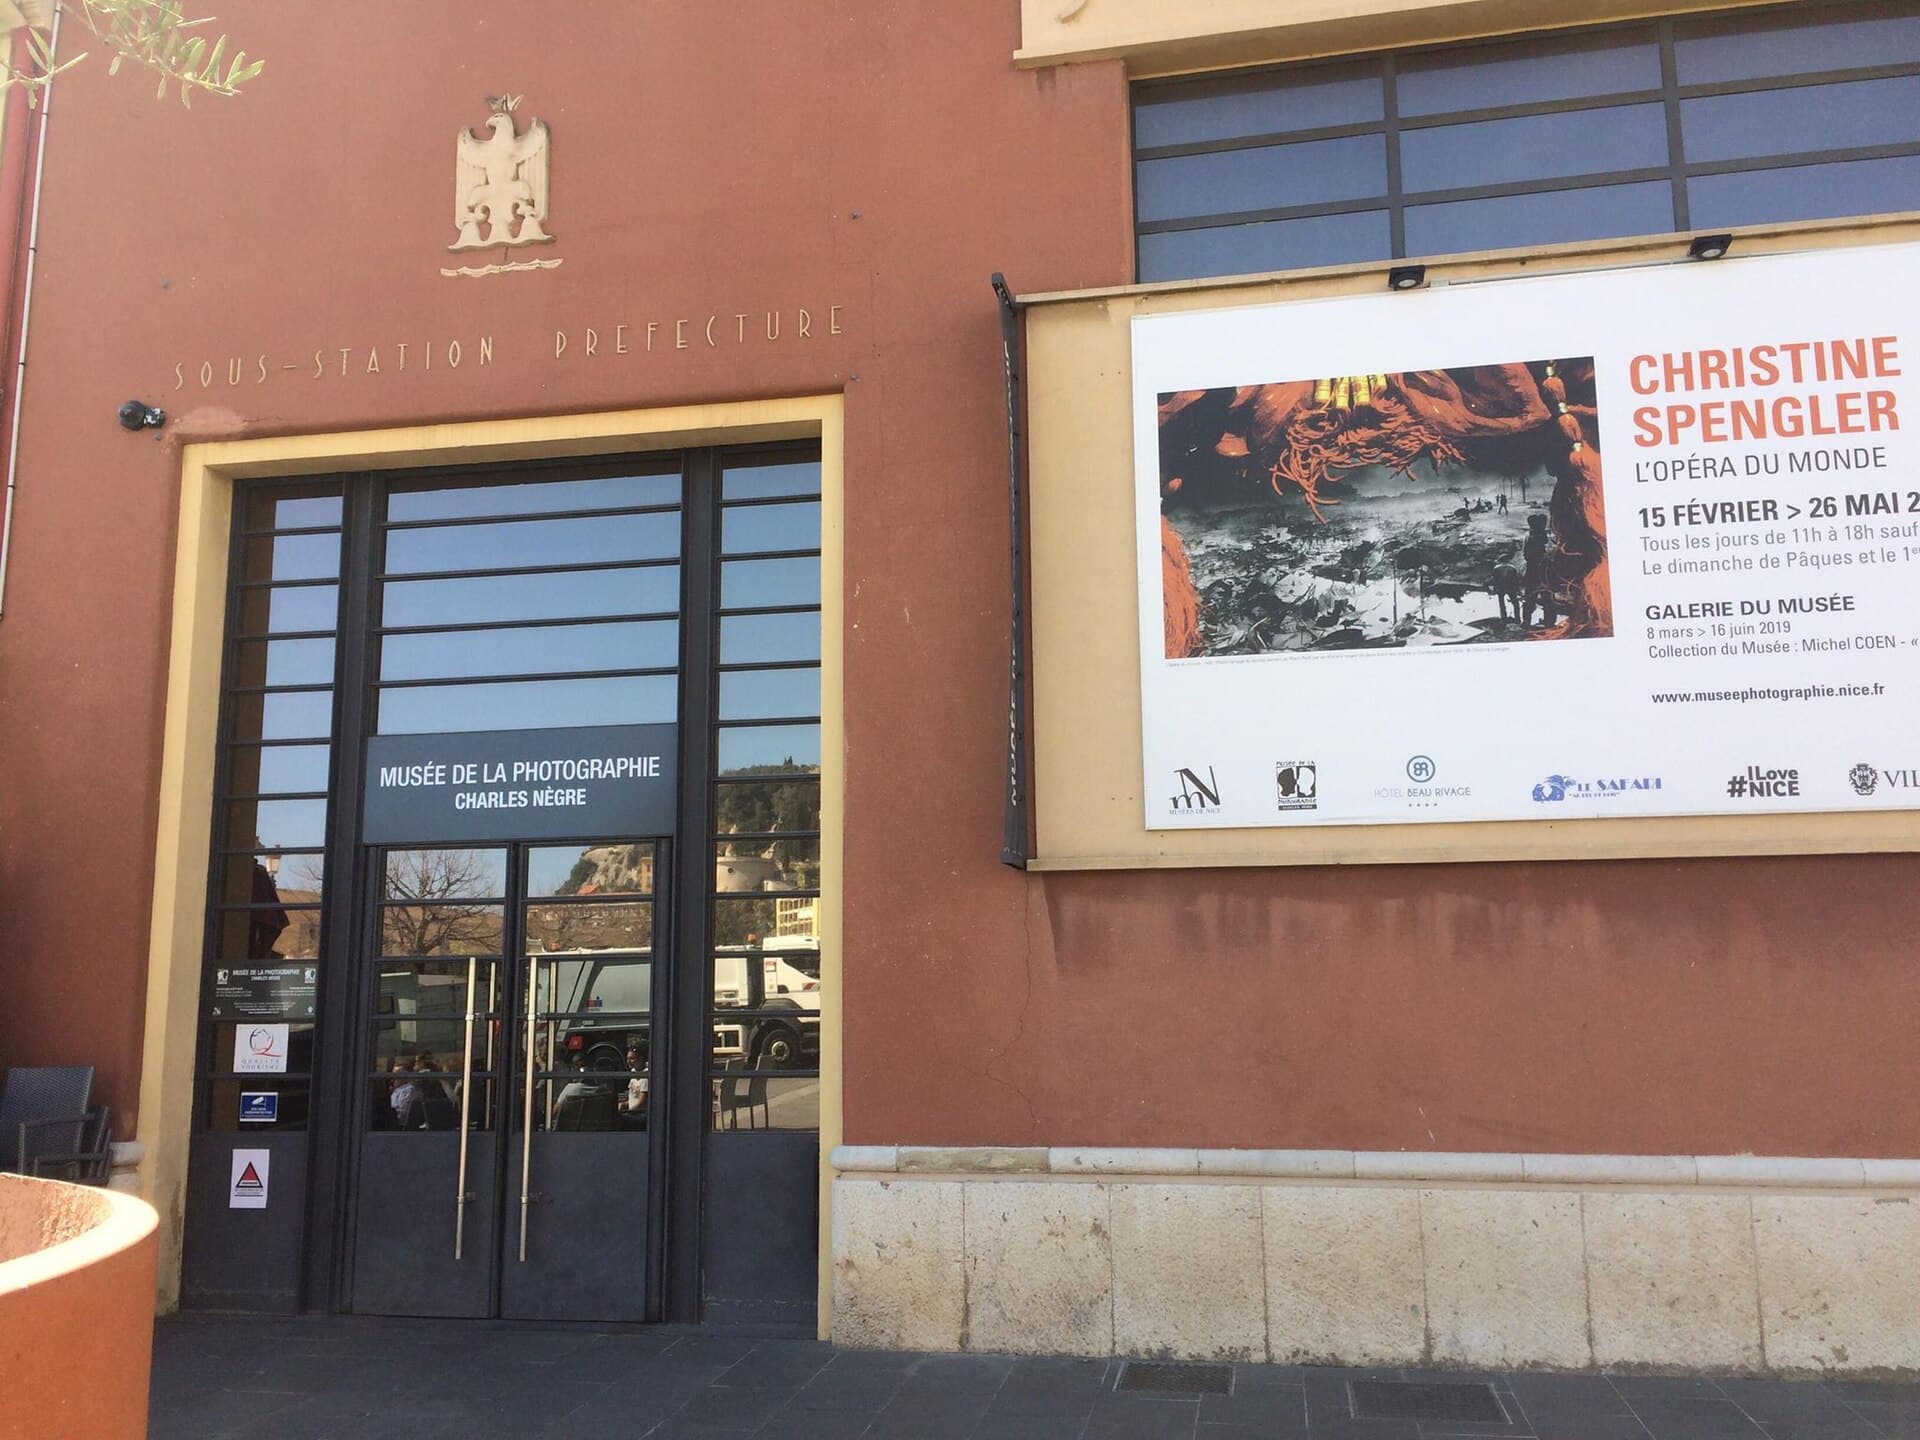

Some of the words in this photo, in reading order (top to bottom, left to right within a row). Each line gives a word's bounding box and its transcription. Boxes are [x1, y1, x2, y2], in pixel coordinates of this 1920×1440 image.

[556, 305, 842, 359] PREFECTURE
[1629, 336, 1901, 395] CHRISTINE
[1633, 390, 1899, 447] SPENGLER
[1745, 453, 1779, 475] DU
[1789, 447, 1887, 473] MONDE
[1638, 507, 1666, 528] 15
[1673, 498, 1779, 526] FÉVRIER
[1809, 496, 1837, 518] 26
[1845, 492, 1899, 516] MAI
[1640, 535, 1681, 552] Tous
[1685, 534, 1710, 549] les
[1715, 532, 1759, 551] jours
[1765, 529, 1786, 545] de
[1792, 527, 1822, 543] 11h
[1828, 527, 1838, 541] à
[1844, 524, 1874, 541] 18h
[1880, 521, 1918, 539] sauf
[1641, 559, 1662, 576] Le
[1668, 554, 1753, 574] dimanche
[1759, 553, 1780, 569] de
[1787, 549, 1853, 570] Pâques
[1859, 549, 1877, 564] et
[1881, 547, 1896, 563] le
[1646, 601, 1733, 620] GALERIE
[1740, 599, 1771, 616] DU
[1778, 593, 1855, 614] MUSÉE
[1647, 627, 1655, 639] 8
[1659, 627, 1693, 639] mars
[1710, 624, 1726, 636] 16
[1729, 623, 1755, 638] juin
[1759, 621, 1791, 634] 2019
[1649, 642, 1717, 658] Collection
[1721, 642, 1738, 655] du
[1742, 639, 1790, 654] Musée
[1802, 637, 1851, 652] Michel
[1855, 635, 1896, 650] COEN
[1652, 683, 1885, 703] www.museephotographie.nice.fr
[379, 761, 446, 787] MUSÉE
[452, 764, 478, 785] DE
[483, 762, 507, 783] LA
[512, 756, 660, 782] PHOTOGRAPHIE
[455, 790, 528, 810] CHARLES
[533, 786, 587, 807] NÈGRE
[1407, 788, 1432, 797] BEAU
[1435, 787, 1471, 797] RIVAGE
